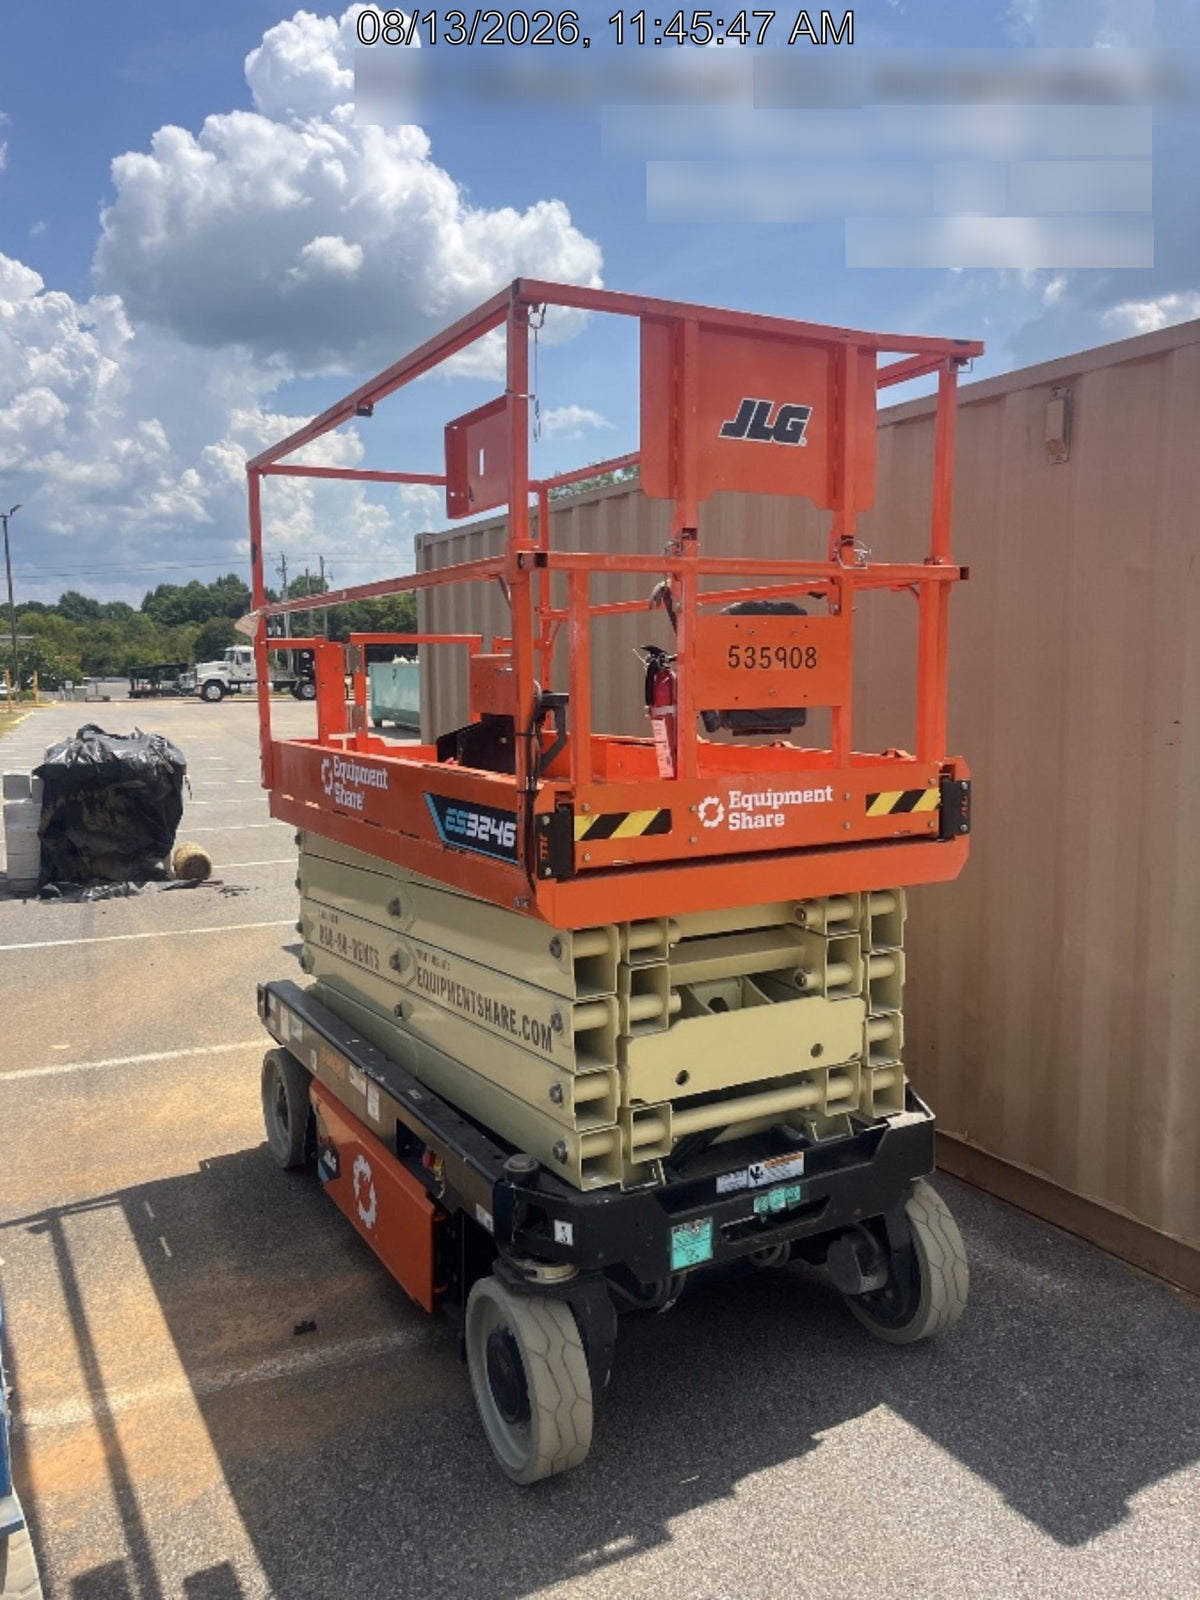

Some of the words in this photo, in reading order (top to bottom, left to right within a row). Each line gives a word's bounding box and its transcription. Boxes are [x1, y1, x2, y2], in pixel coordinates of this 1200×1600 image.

[718, 398, 813, 446] JLG
[728, 645, 818, 669] 535908
[333, 755, 388, 790] Equipment
[334, 782, 363, 811] Share
[728, 785, 833, 811] Equipment
[445, 807, 517, 848] ES3246
[728, 812, 785, 831] Share
[417, 966, 552, 1053] EQUIPMENTSHARE.COM
